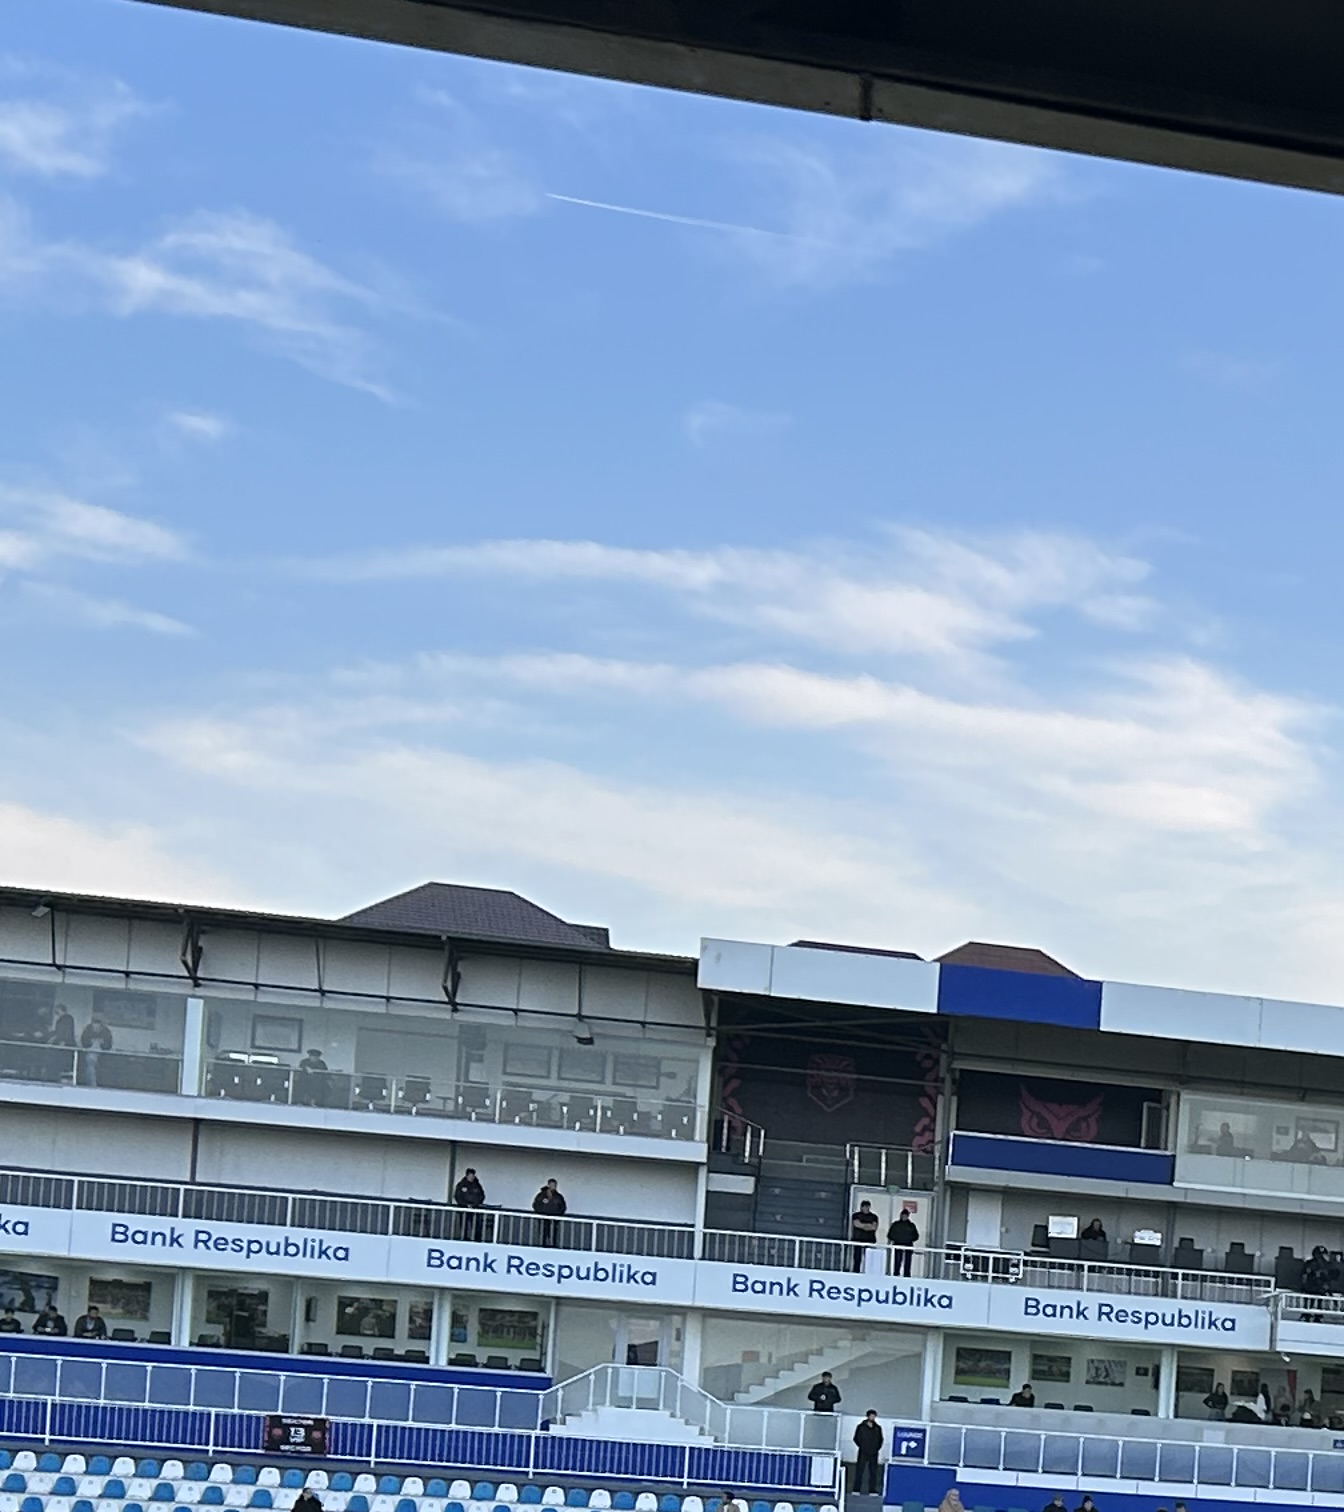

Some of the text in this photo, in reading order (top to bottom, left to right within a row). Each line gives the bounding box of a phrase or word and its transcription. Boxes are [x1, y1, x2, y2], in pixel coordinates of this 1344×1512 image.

[111, 1222, 350, 1262] Bank Respublika
[427, 1248, 657, 1286] Bank Respublika
[731, 1273, 953, 1309] Bank Respublika
[1023, 1296, 1237, 1332] Bank Respublika
